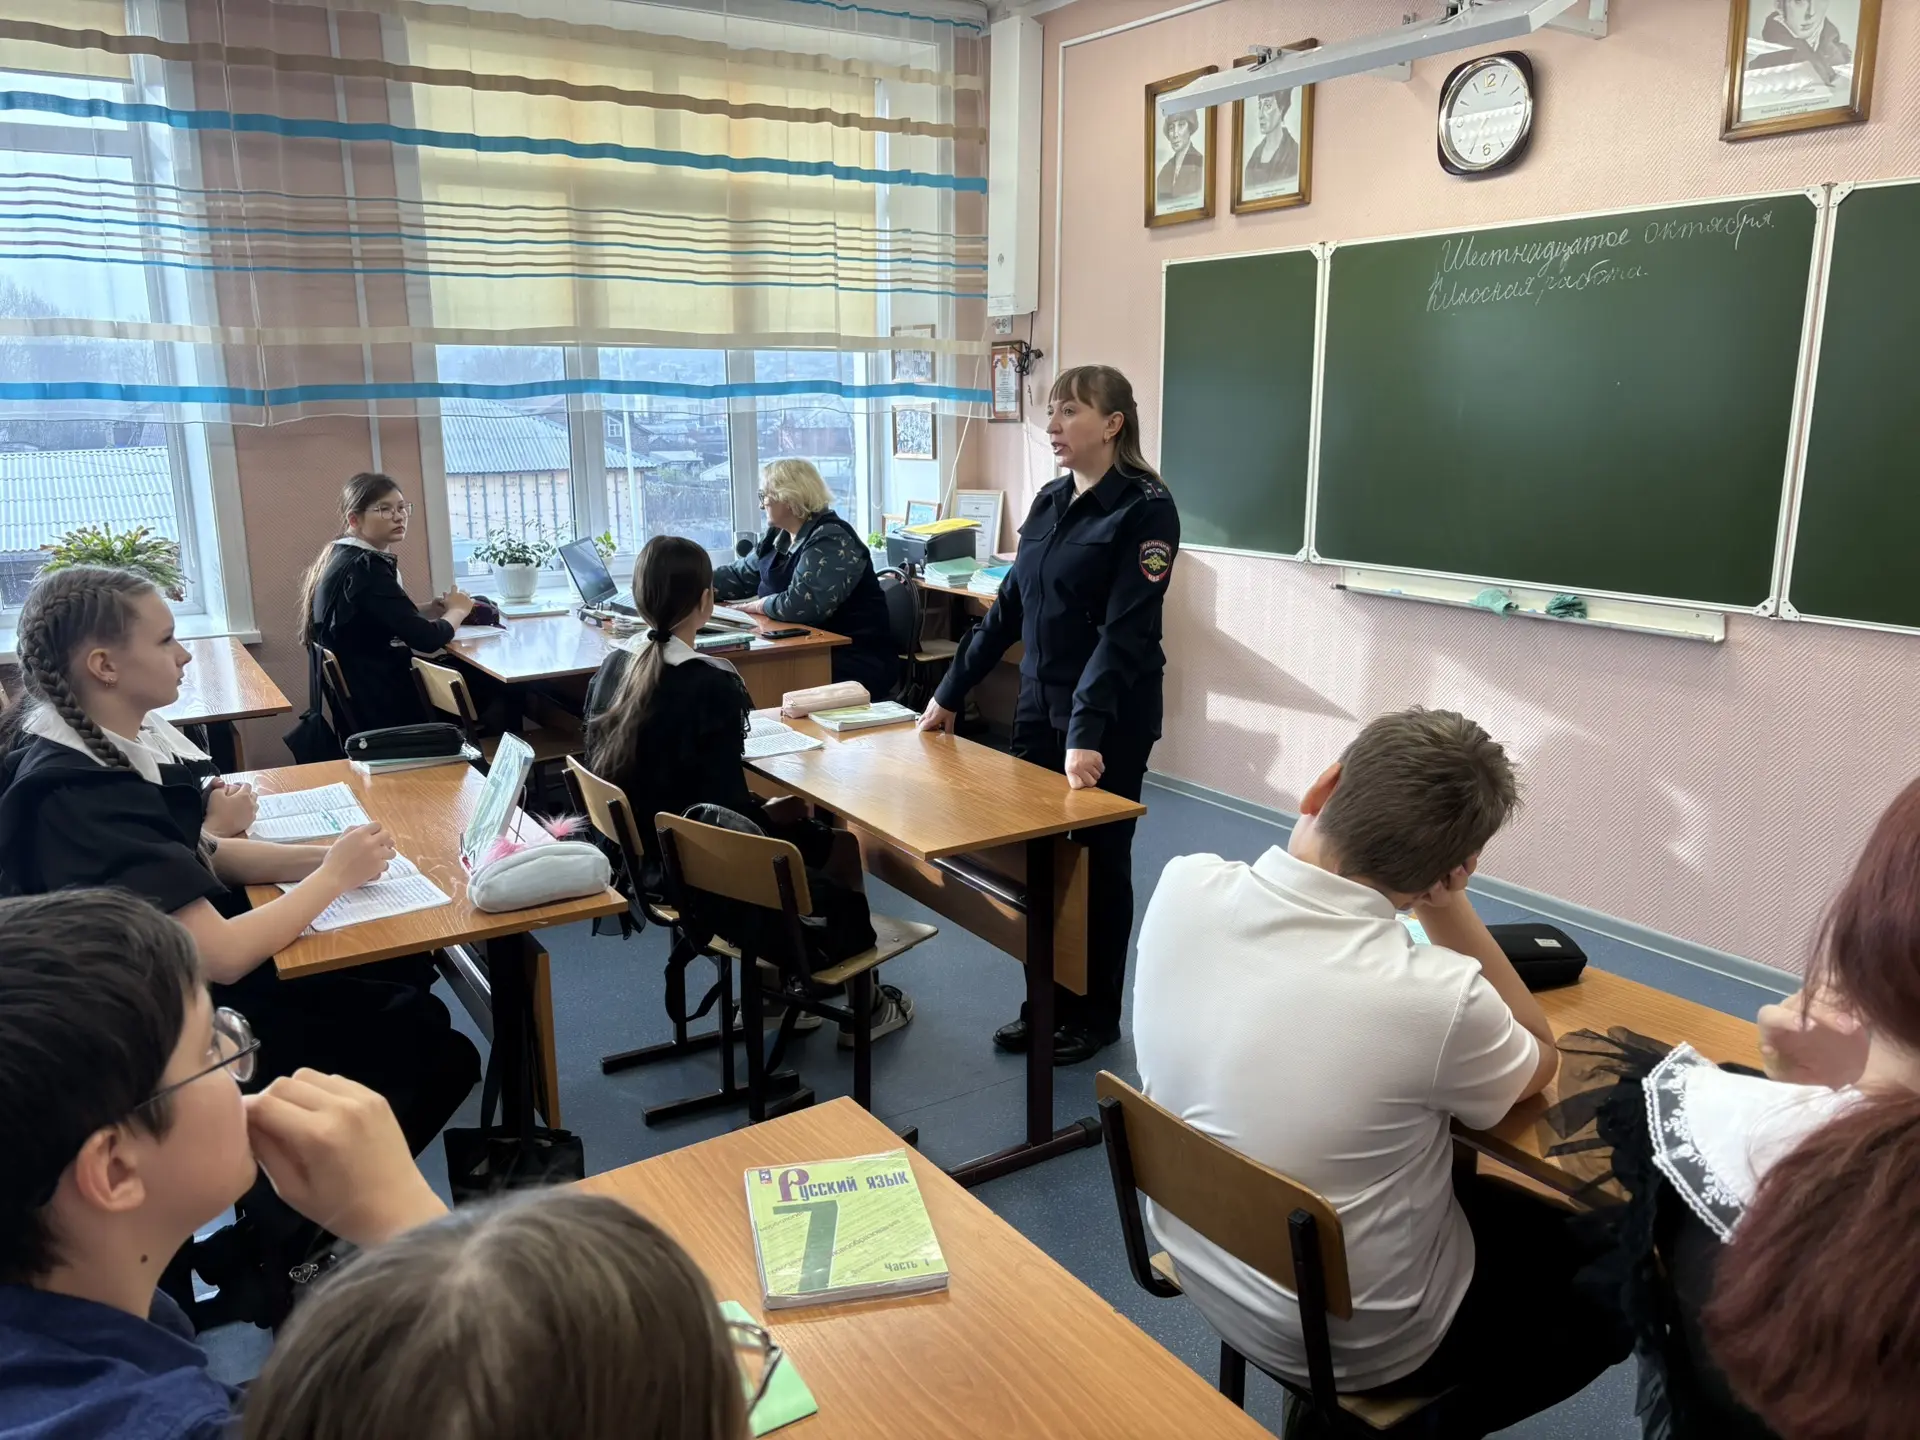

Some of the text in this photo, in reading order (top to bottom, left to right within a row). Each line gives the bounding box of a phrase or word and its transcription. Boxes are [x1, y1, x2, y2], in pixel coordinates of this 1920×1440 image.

[1484, 72, 1496, 88] 12
[1483, 143, 1491, 156] 6
[777, 1168, 909, 1202] Русский язык
[773, 1200, 837, 1292] 7
[885, 1260, 918, 1272] Часть
